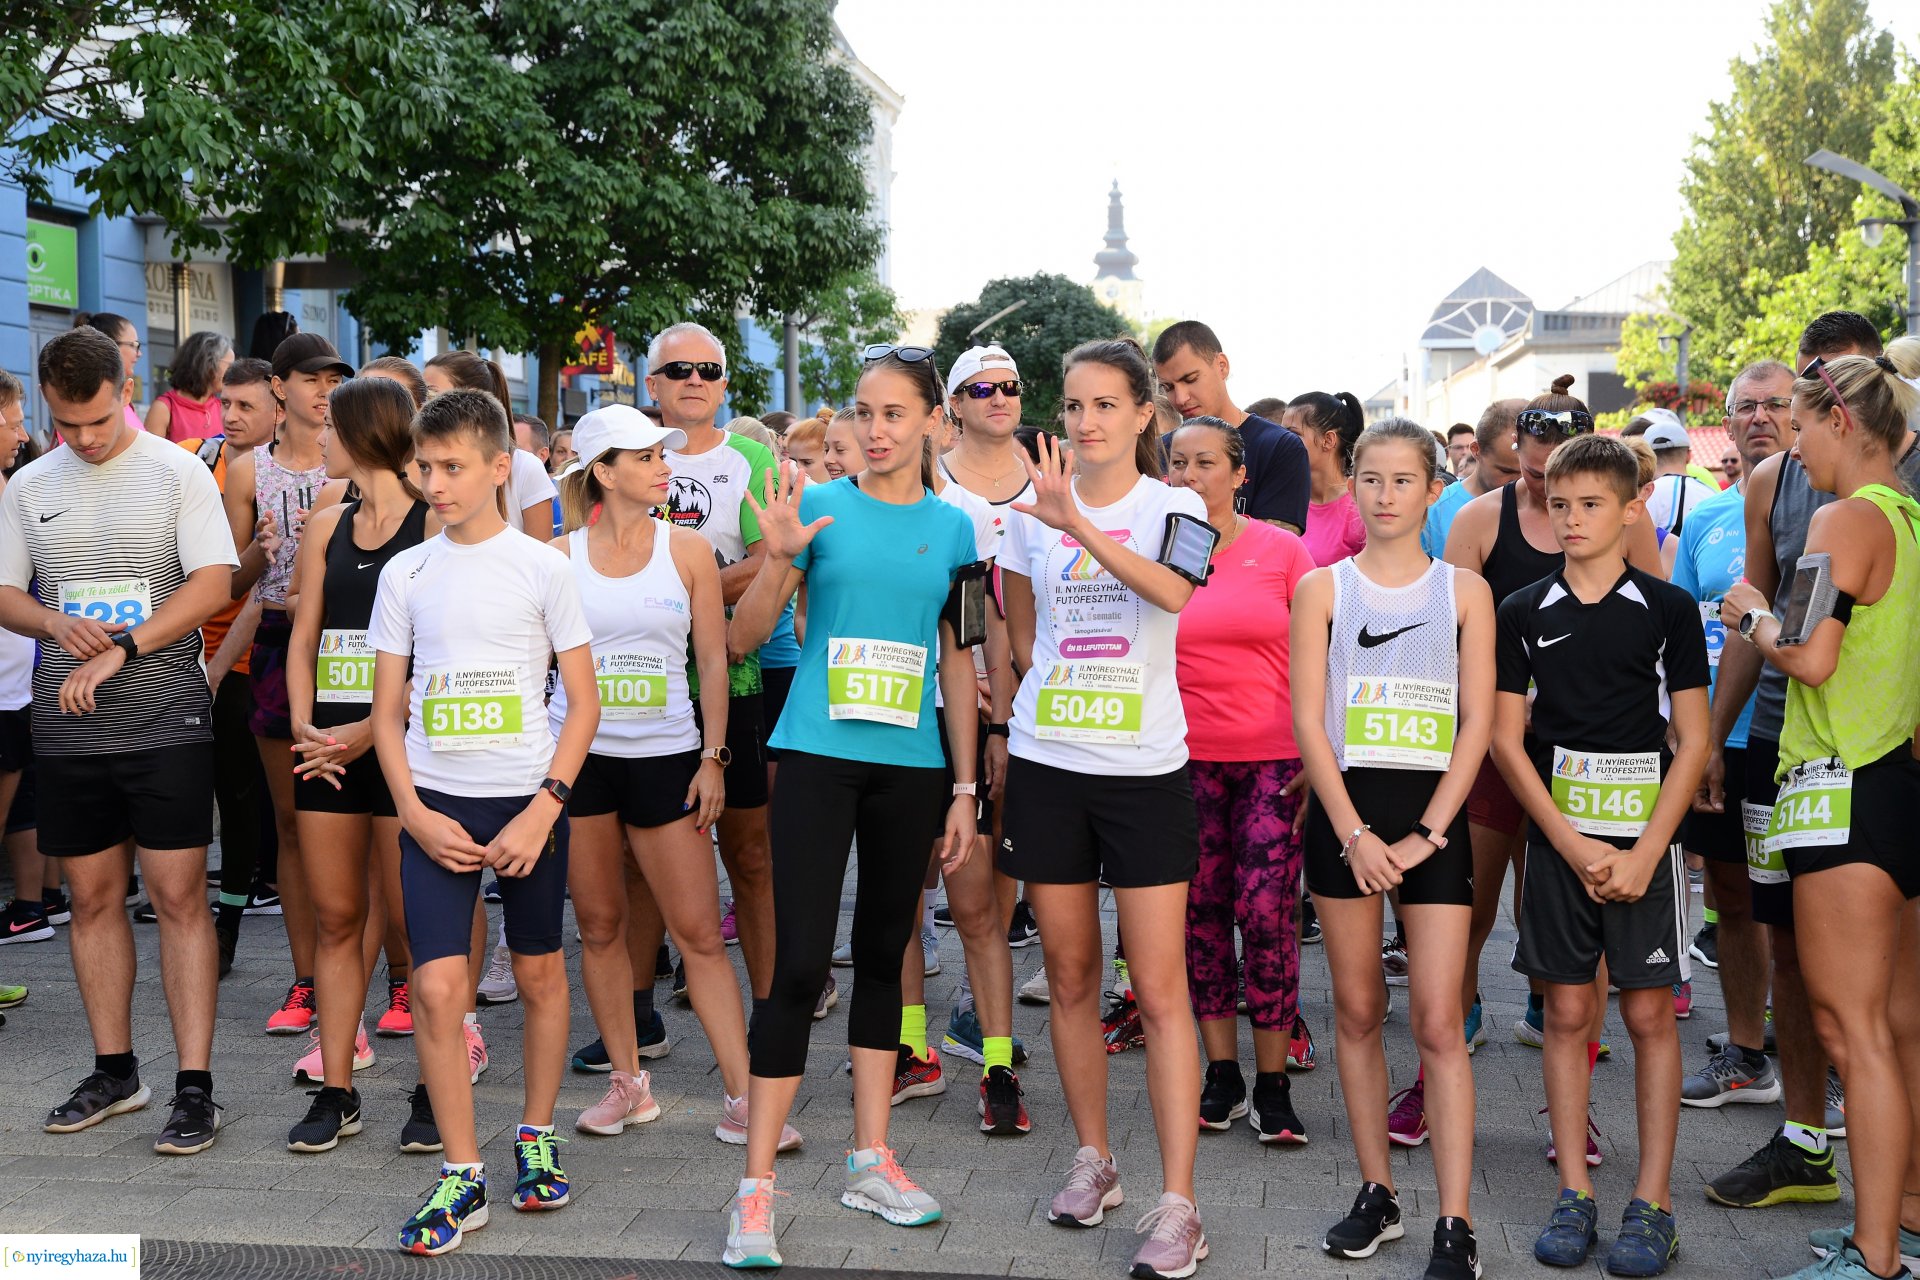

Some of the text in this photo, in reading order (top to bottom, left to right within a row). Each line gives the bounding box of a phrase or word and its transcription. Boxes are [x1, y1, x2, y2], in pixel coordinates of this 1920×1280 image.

[1065, 581, 1128, 594] NYÍREGYHÁZI
[1055, 593, 1129, 605] FUTÓFESZTIVÁL
[1092, 612, 1122, 621] sematic
[328, 661, 376, 686] 501
[454, 677, 517, 688] FUTÓFESZTIVÁL
[1078, 672, 1139, 684] FUTÓFESZTIVÁL
[845, 672, 910, 705] 5117
[1393, 690, 1452, 705] FUTÓFESZTIVÁL
[431, 702, 504, 731] 5138
[1050, 694, 1125, 726] 5049
[1364, 712, 1438, 746] 5143
[1595, 765, 1657, 774] FUTÓFESZTIVÁL
[1567, 785, 1644, 817] 5146
[1777, 795, 1833, 831] 5144
